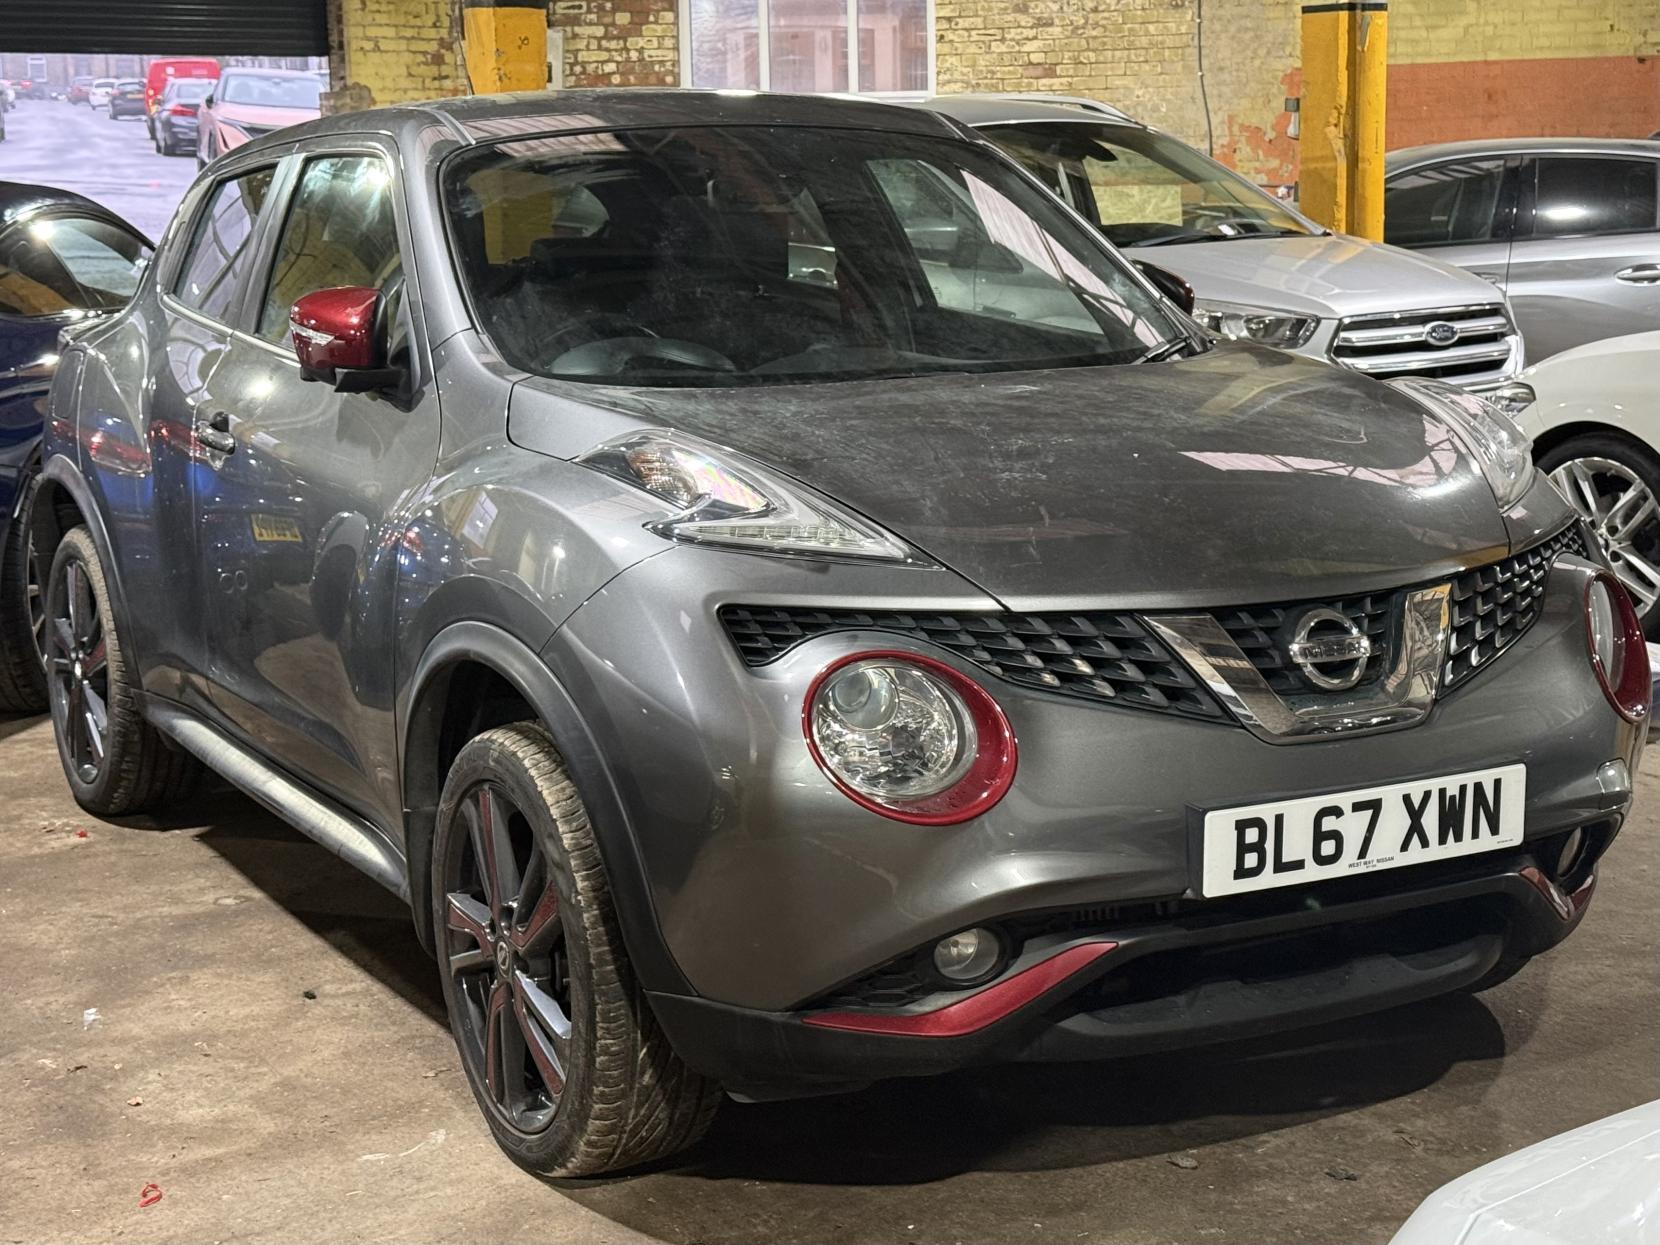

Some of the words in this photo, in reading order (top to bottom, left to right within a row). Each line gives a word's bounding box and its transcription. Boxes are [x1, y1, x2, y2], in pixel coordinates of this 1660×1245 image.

[1233, 797, 1383, 881] BL67
[1399, 777, 1502, 853] XWN
[1348, 861, 1362, 869] WEST
